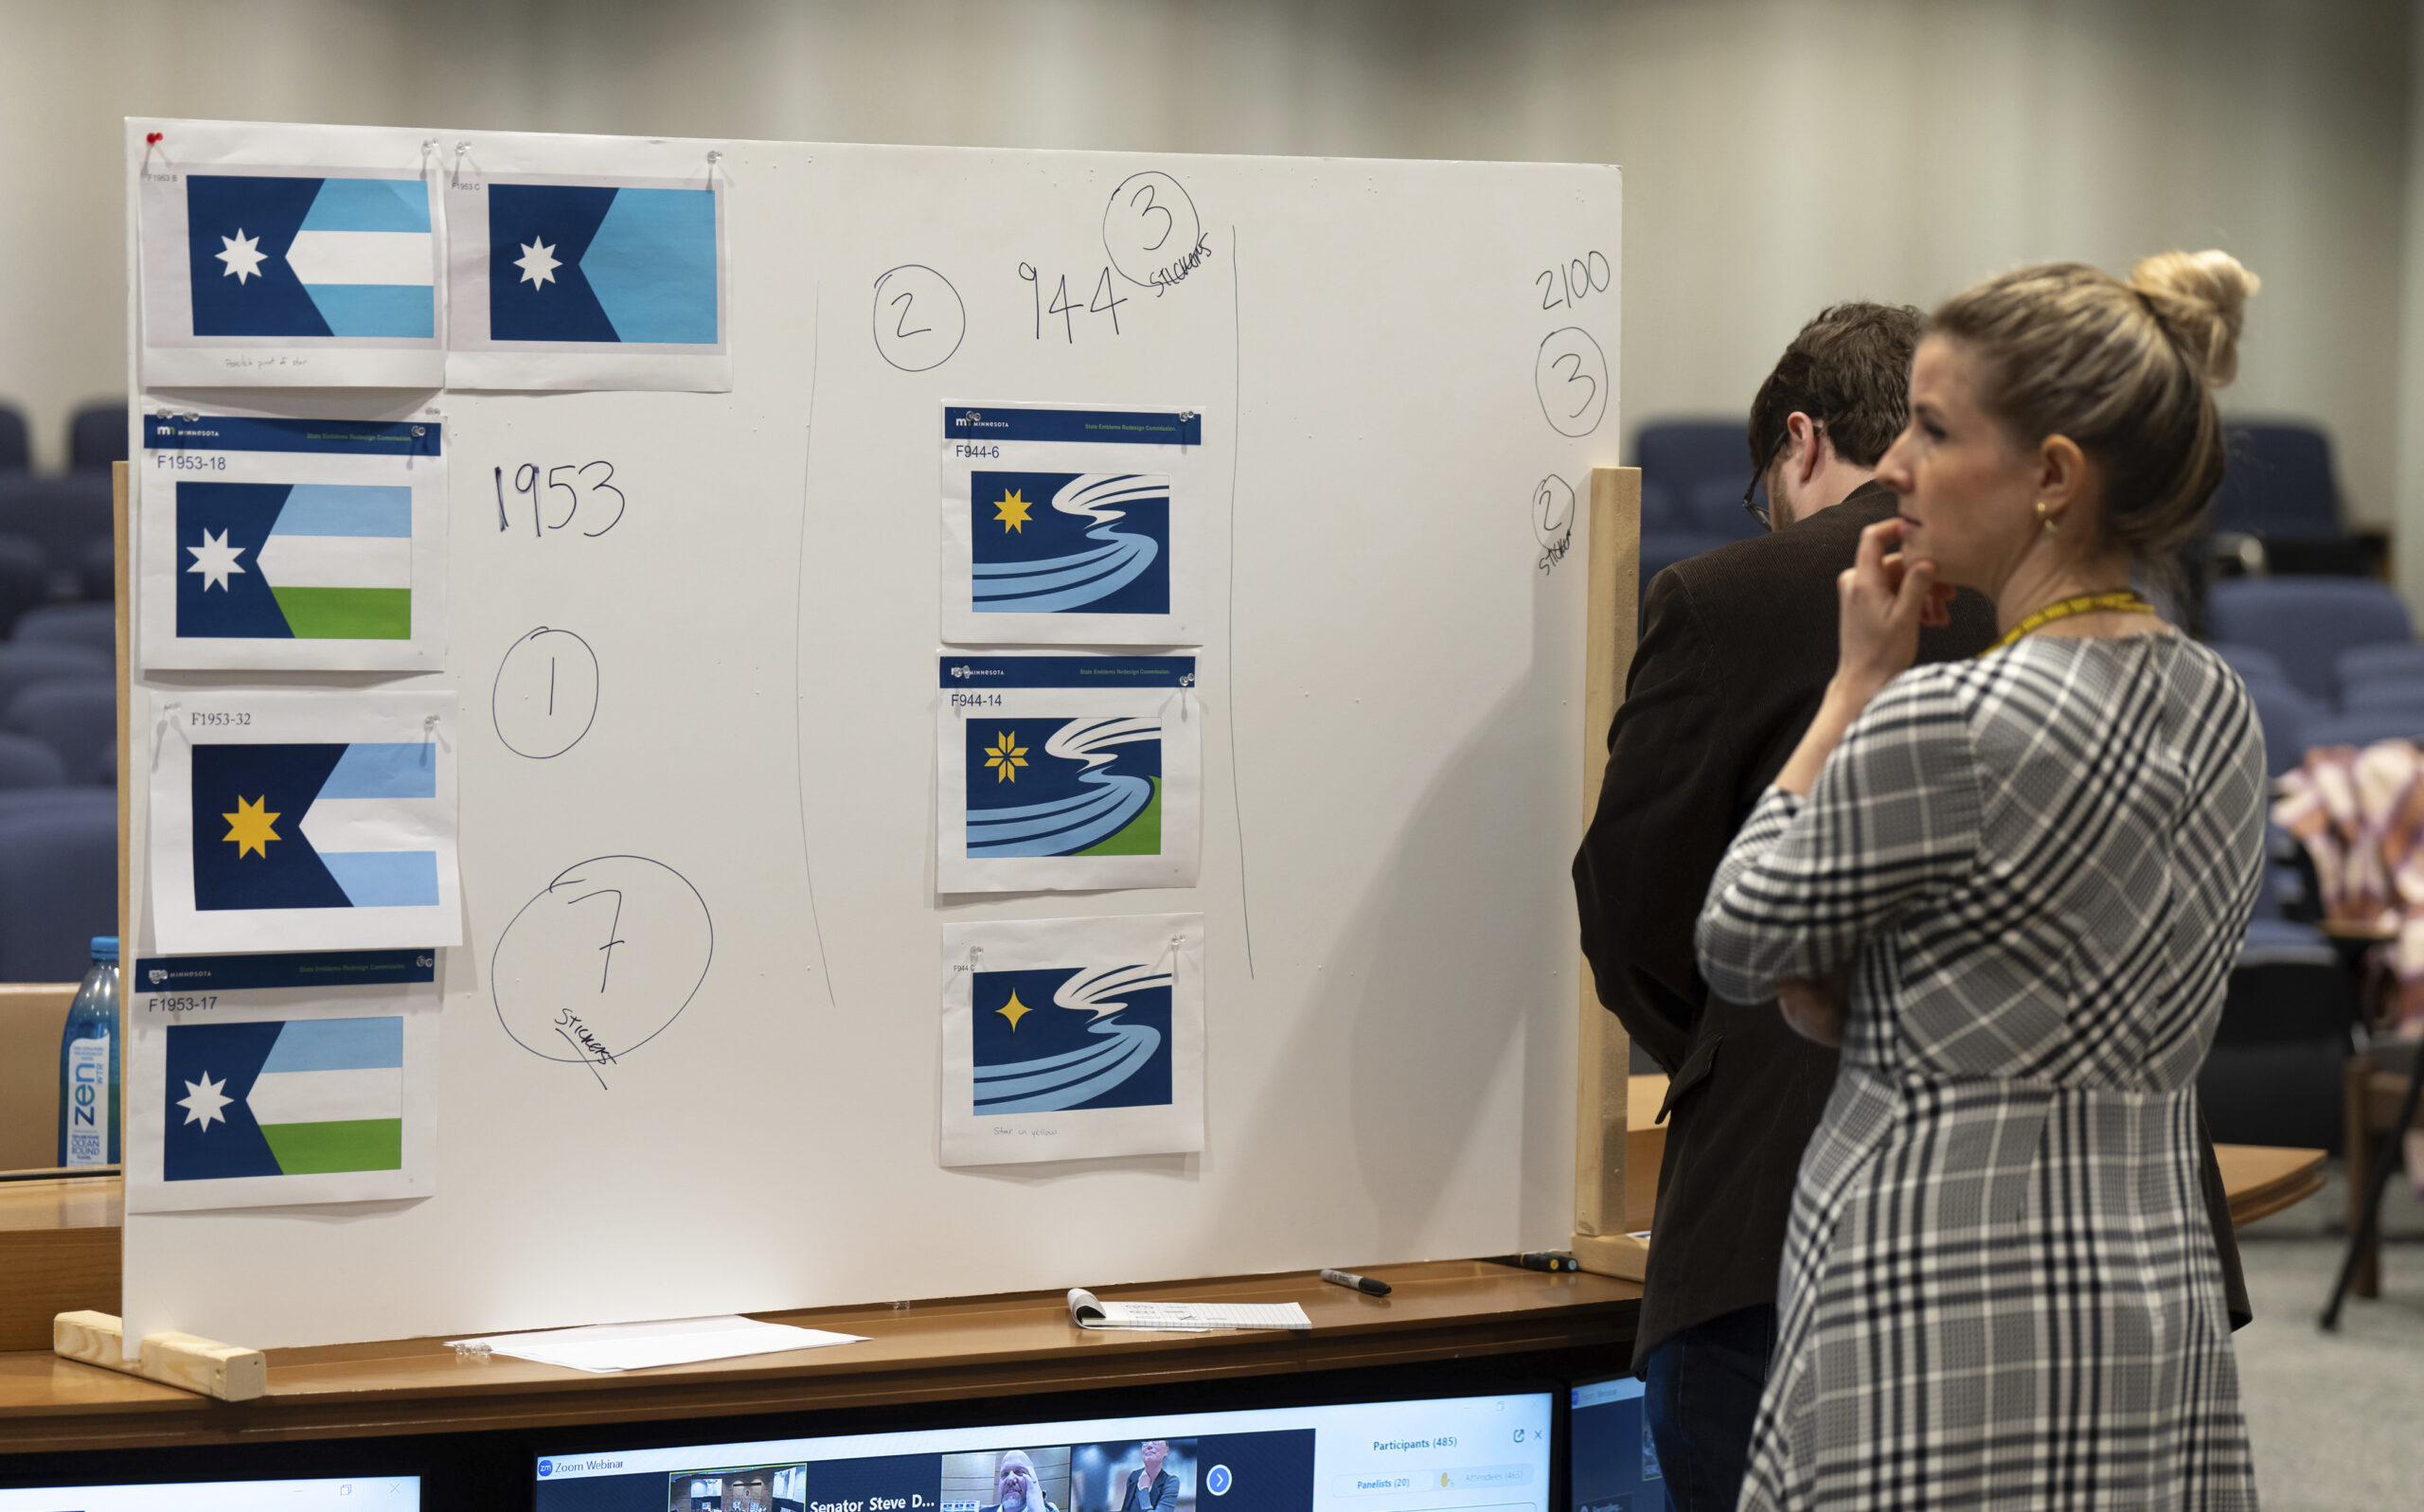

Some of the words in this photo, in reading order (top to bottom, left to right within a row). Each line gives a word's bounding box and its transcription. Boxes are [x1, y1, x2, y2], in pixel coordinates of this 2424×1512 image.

[1131, 185, 1172, 251] 3
[1535, 250, 1611, 311] 2100
[890, 292, 933, 338] 2
[1018, 261, 1129, 345] 944
[1551, 352, 1596, 418] 3
[156, 454, 227, 471] F1953-18
[955, 444, 1000, 459] F944-6
[493, 460, 626, 538] 1953
[1539, 489, 1562, 532] 2
[951, 693, 1003, 707] F944-14
[190, 712, 252, 726] F1953-32
[568, 889, 625, 993] 7
[148, 996, 218, 1012] F1953-17
[75, 1062, 95, 1127] zen
[1373, 1439, 1431, 1452] Participants
[1433, 1436, 1458, 1450] (485)
[555, 1462, 584, 1473] Zoom
[586, 1459, 624, 1470] Webinar
[1357, 1479, 1392, 1489] Panelists
[1394, 1477, 1410, 1489] (20)
[810, 1499, 864, 1512] Senator
[869, 1496, 907, 1511] Steve
[911, 1493, 936, 1509] D...
